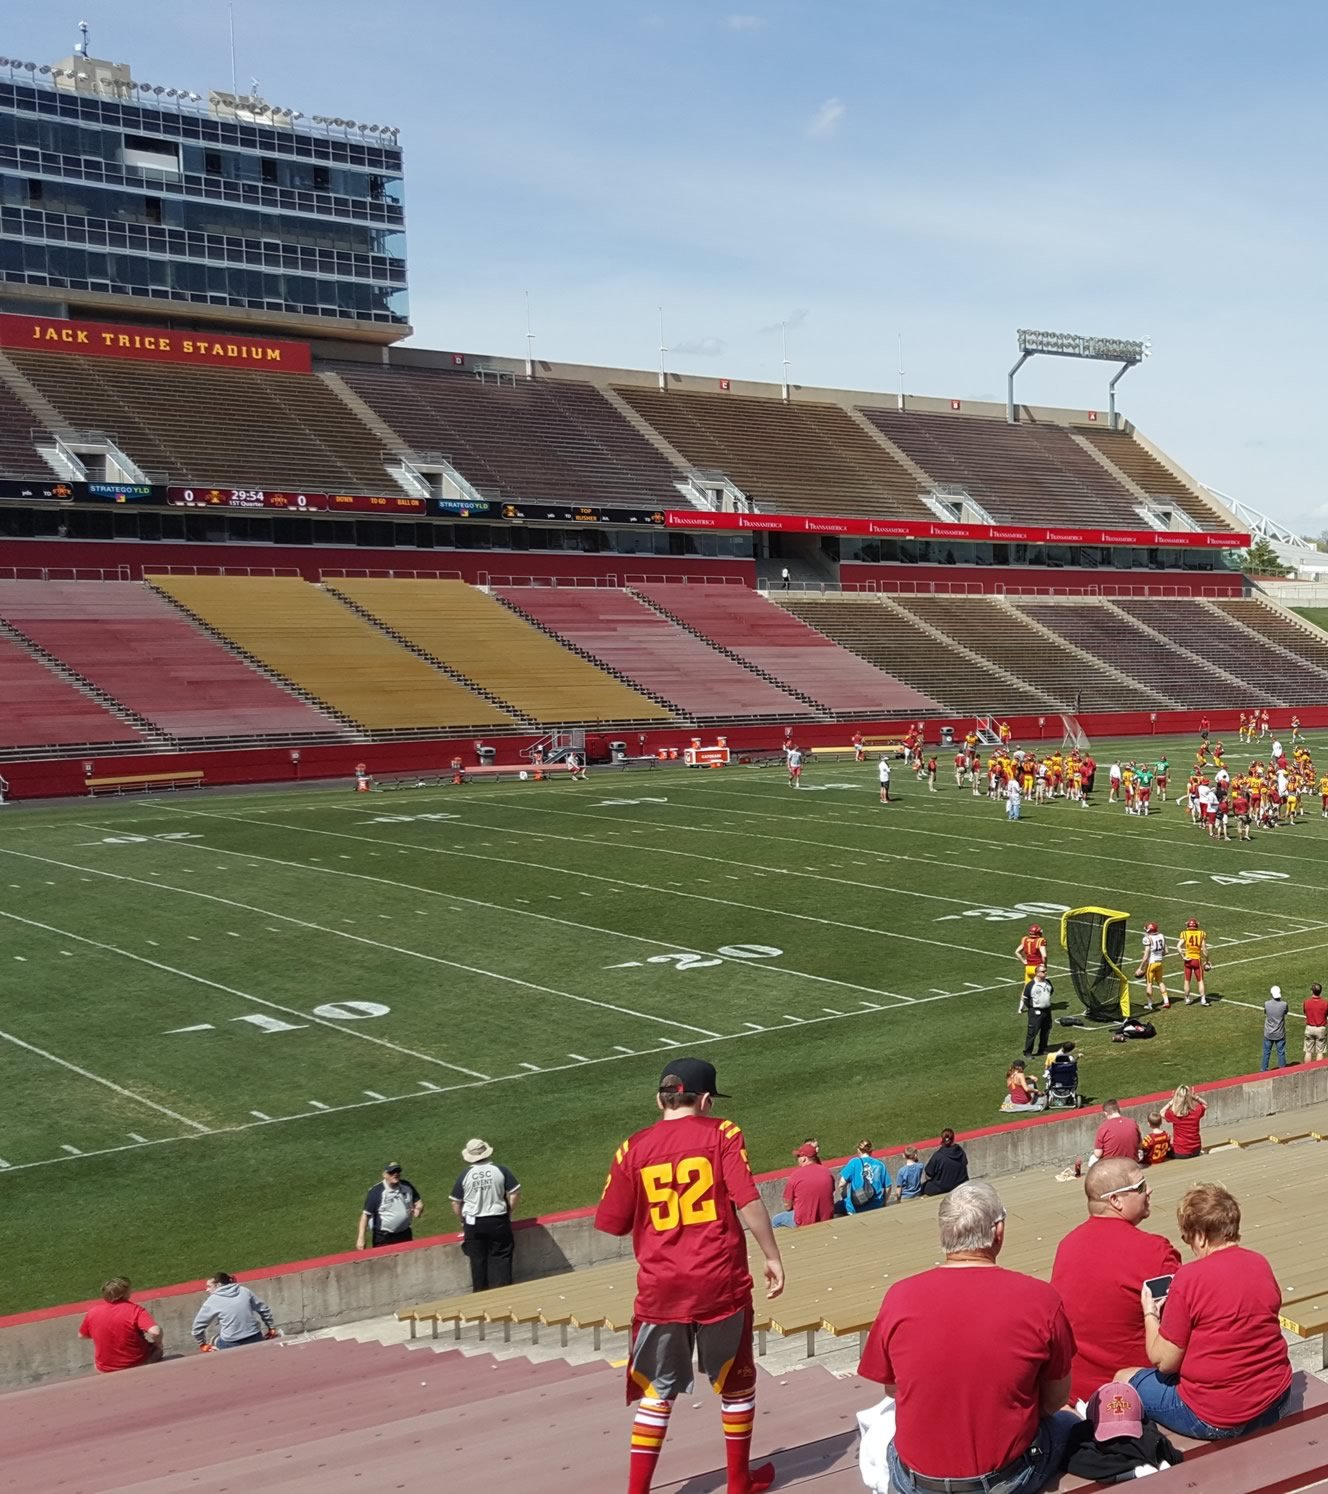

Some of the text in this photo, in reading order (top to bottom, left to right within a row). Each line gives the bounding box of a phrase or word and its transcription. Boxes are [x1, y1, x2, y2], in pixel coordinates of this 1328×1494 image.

[33, 326, 281, 361] JACK TRICE STADIUM
[90, 485, 150, 494] STRATEGO YLD
[184, 490, 194, 501] 0
[231, 490, 264, 501] 29:54
[297, 495, 307, 506] 0
[439, 501, 489, 510] STRATEGO YLD
[1210, 871, 1290, 885] 40
[962, 902, 1072, 921] 30
[1155, 939, 1163, 952] 13
[1189, 935, 1199, 947] 41
[647, 944, 783, 970] 20
[230, 1001, 390, 1034] 10
[1152, 1142, 1169, 1160] 52
[472, 1170, 492, 1180] CSC
[472, 1179, 493, 1187] EVENT
[640, 1156, 718, 1232] 52
